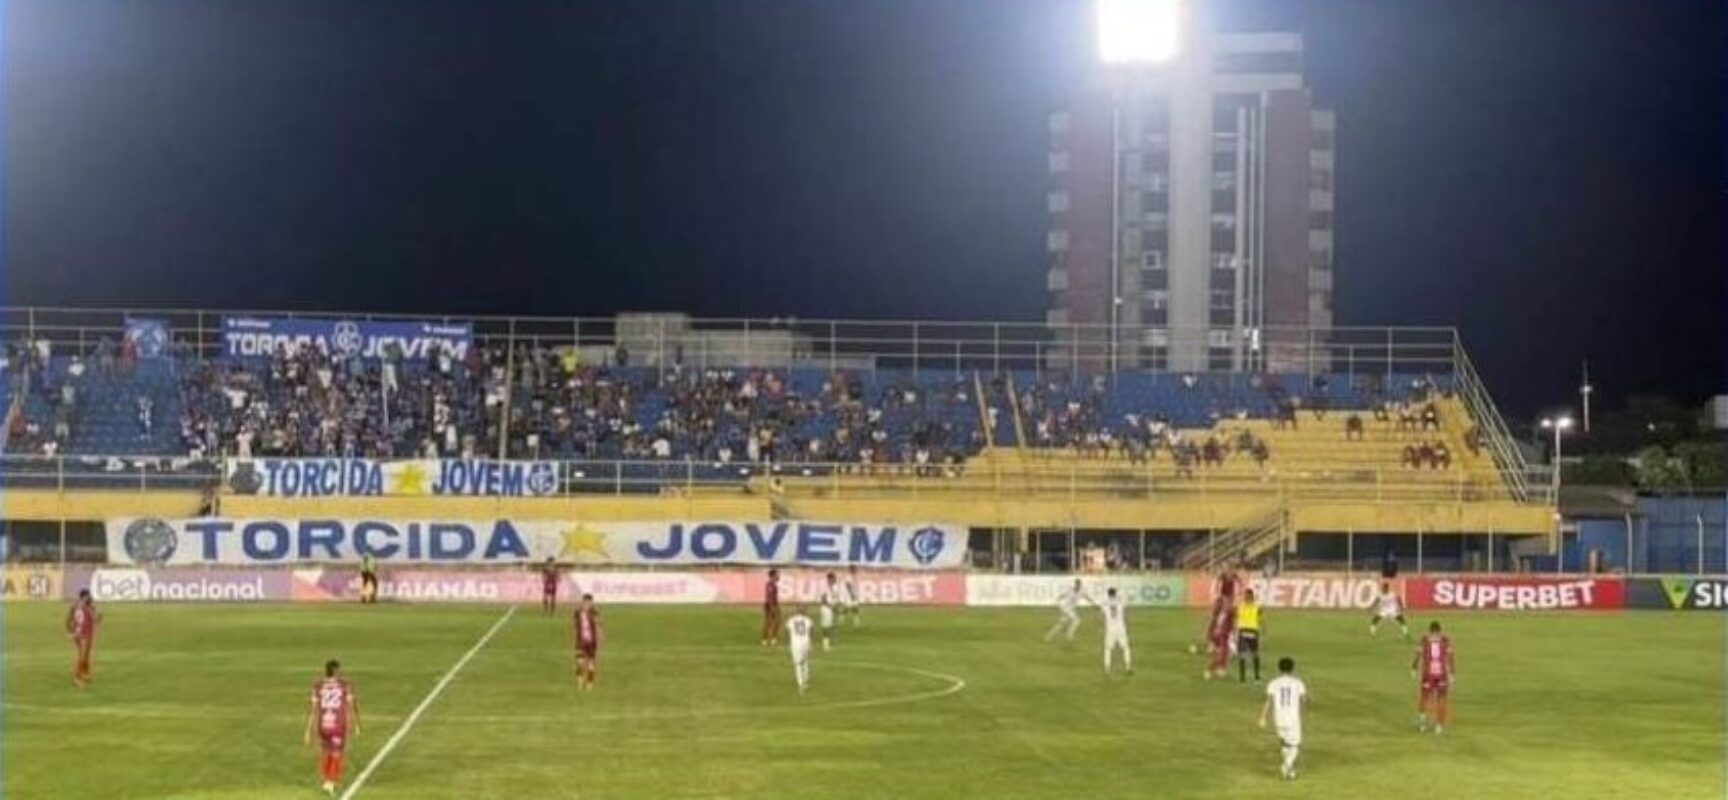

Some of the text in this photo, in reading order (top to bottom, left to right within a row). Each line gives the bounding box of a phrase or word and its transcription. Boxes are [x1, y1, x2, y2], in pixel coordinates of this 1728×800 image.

[265, 458, 524, 496] TORCIDA JOVEM
[185, 519, 896, 562] TORCIDA JOVEM
[1433, 580, 1595, 609] SUPERBET
[1695, 582, 1728, 607] SI
[1279, 686, 1291, 707] 11
